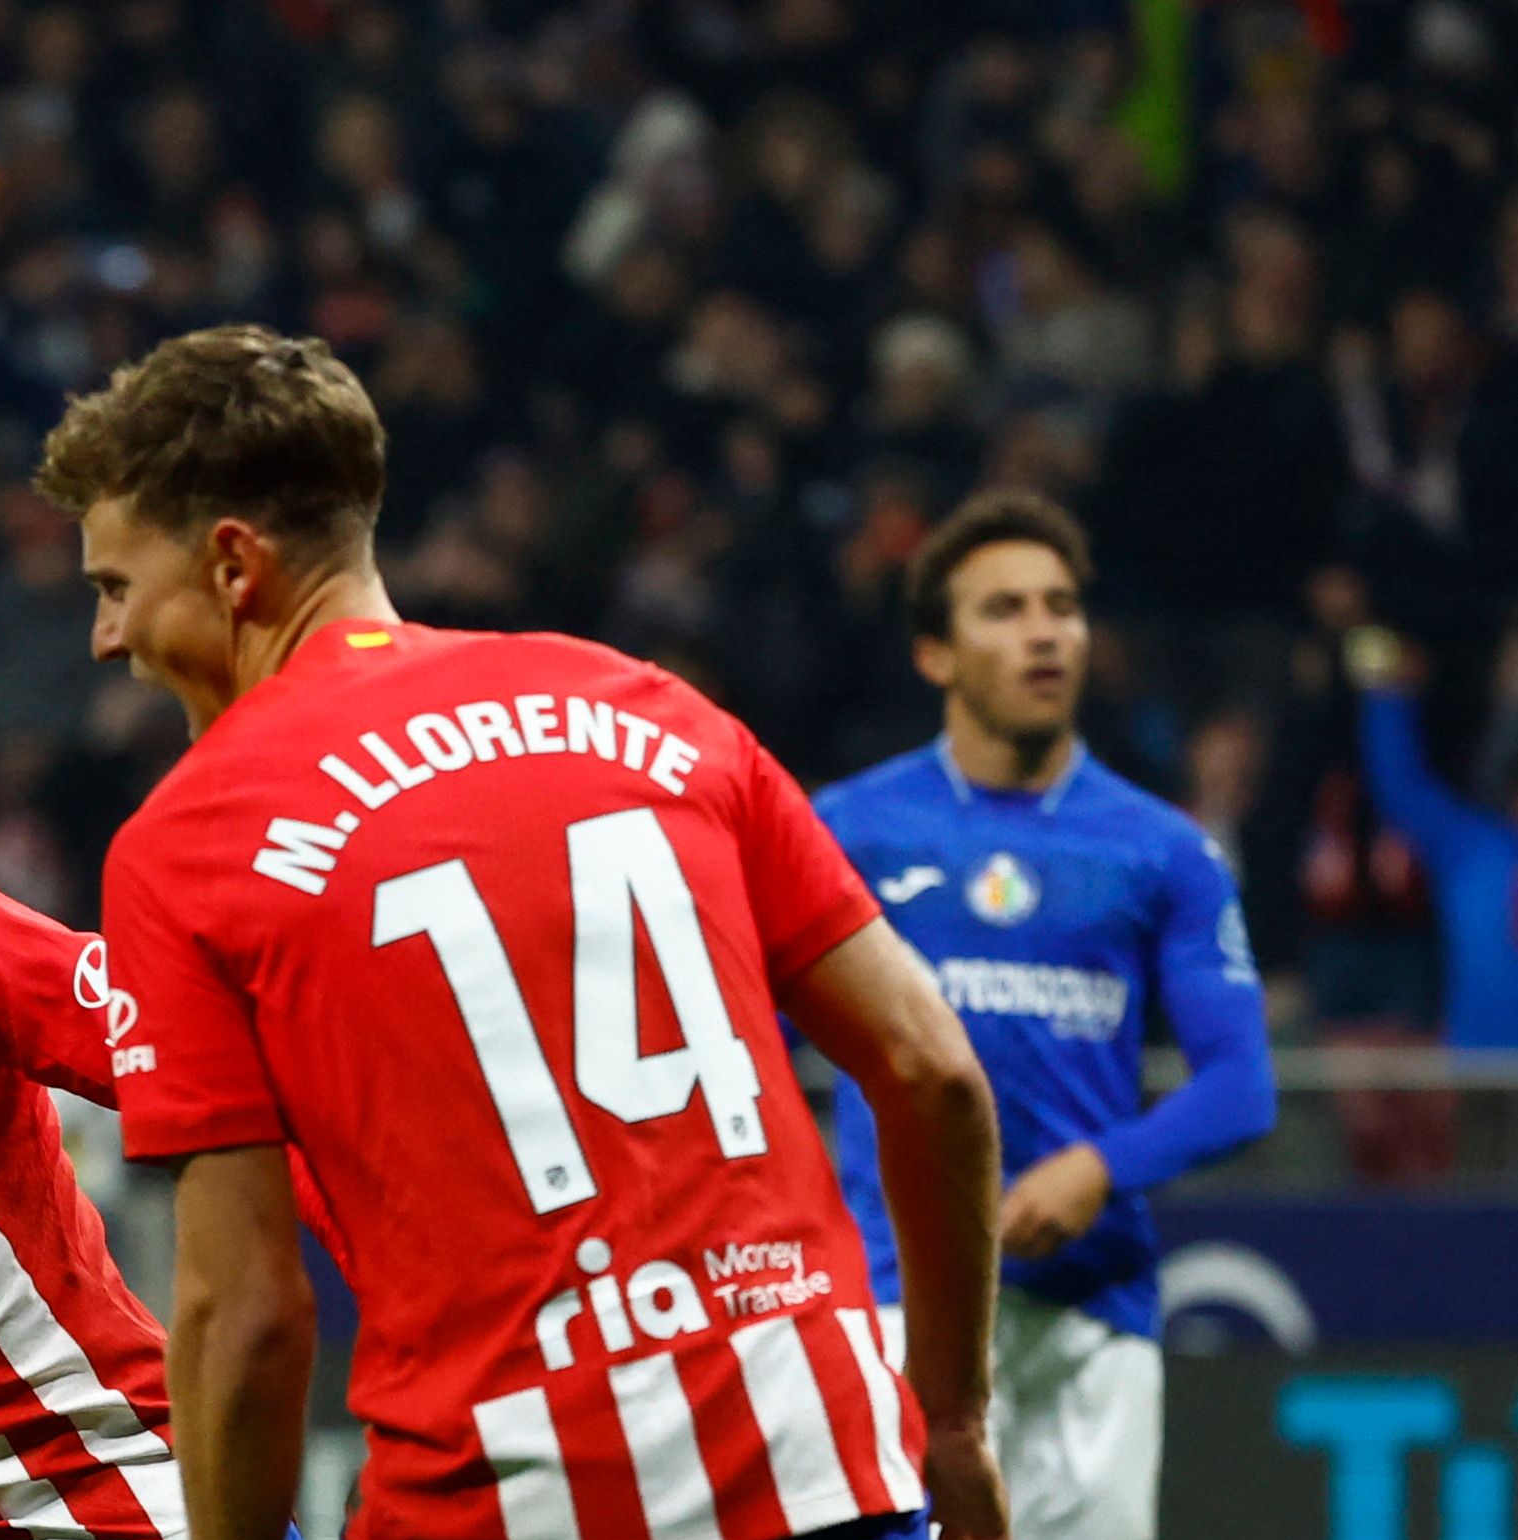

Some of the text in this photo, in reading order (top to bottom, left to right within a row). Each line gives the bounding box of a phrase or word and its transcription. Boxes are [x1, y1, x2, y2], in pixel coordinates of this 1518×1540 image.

[252, 694, 701, 896] M. LLORENTE
[371, 806, 768, 1216] 14
[535, 1236, 711, 1372] ria
[703, 1240, 804, 1282] Money
